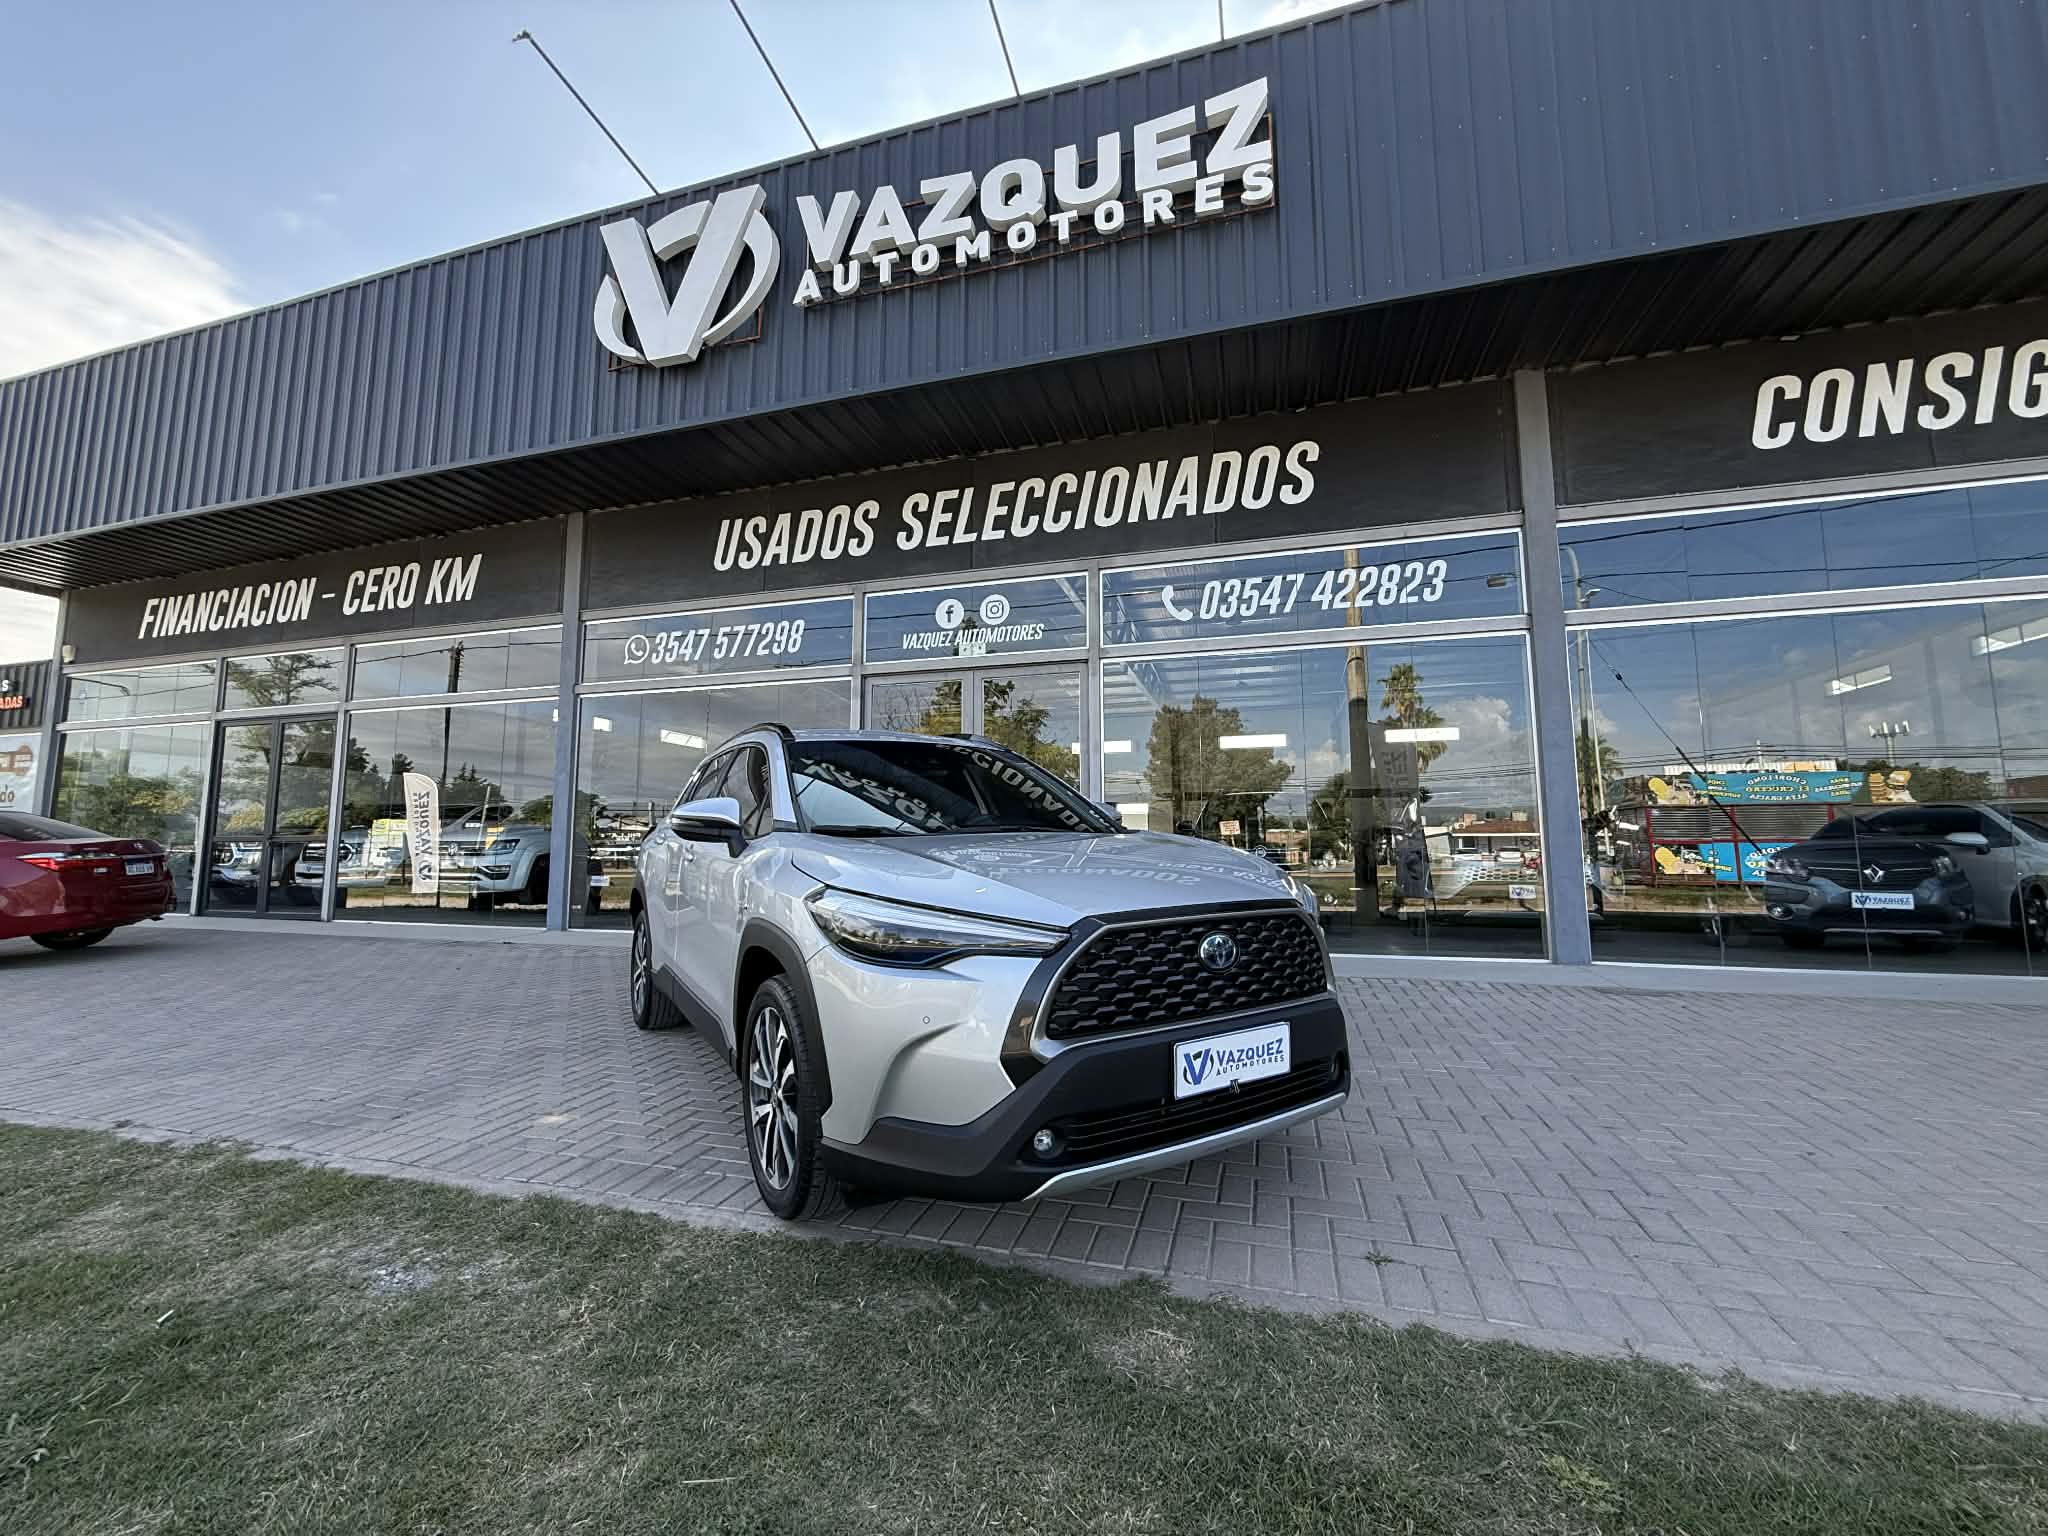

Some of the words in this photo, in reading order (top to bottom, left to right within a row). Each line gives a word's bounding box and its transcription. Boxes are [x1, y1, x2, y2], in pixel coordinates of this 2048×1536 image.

[796, 77, 1272, 273] VAZQUEZ
[793, 163, 1275, 307] AUTOMOTORES
[1751, 339, 2048, 450] CONSIG
[713, 499, 880, 571] USADOS
[896, 440, 1320, 551] SELECCIONADOS
[138, 577, 317, 639] FINANCIACION
[342, 562, 420, 616] CERO
[425, 554, 483, 605] KM
[1199, 573, 1305, 620] 03547
[1309, 559, 1447, 611] 422823
[652, 630, 708, 665] 3547
[713, 619, 806, 660] 577298
[903, 630, 953, 650] VAZQUEZ
[954, 623, 1045, 646] AUTOMOTORES
[1216, 1038, 1284, 1067] VAZQUEZ
[1216, 1055, 1285, 1076] AUTOMOTORES
